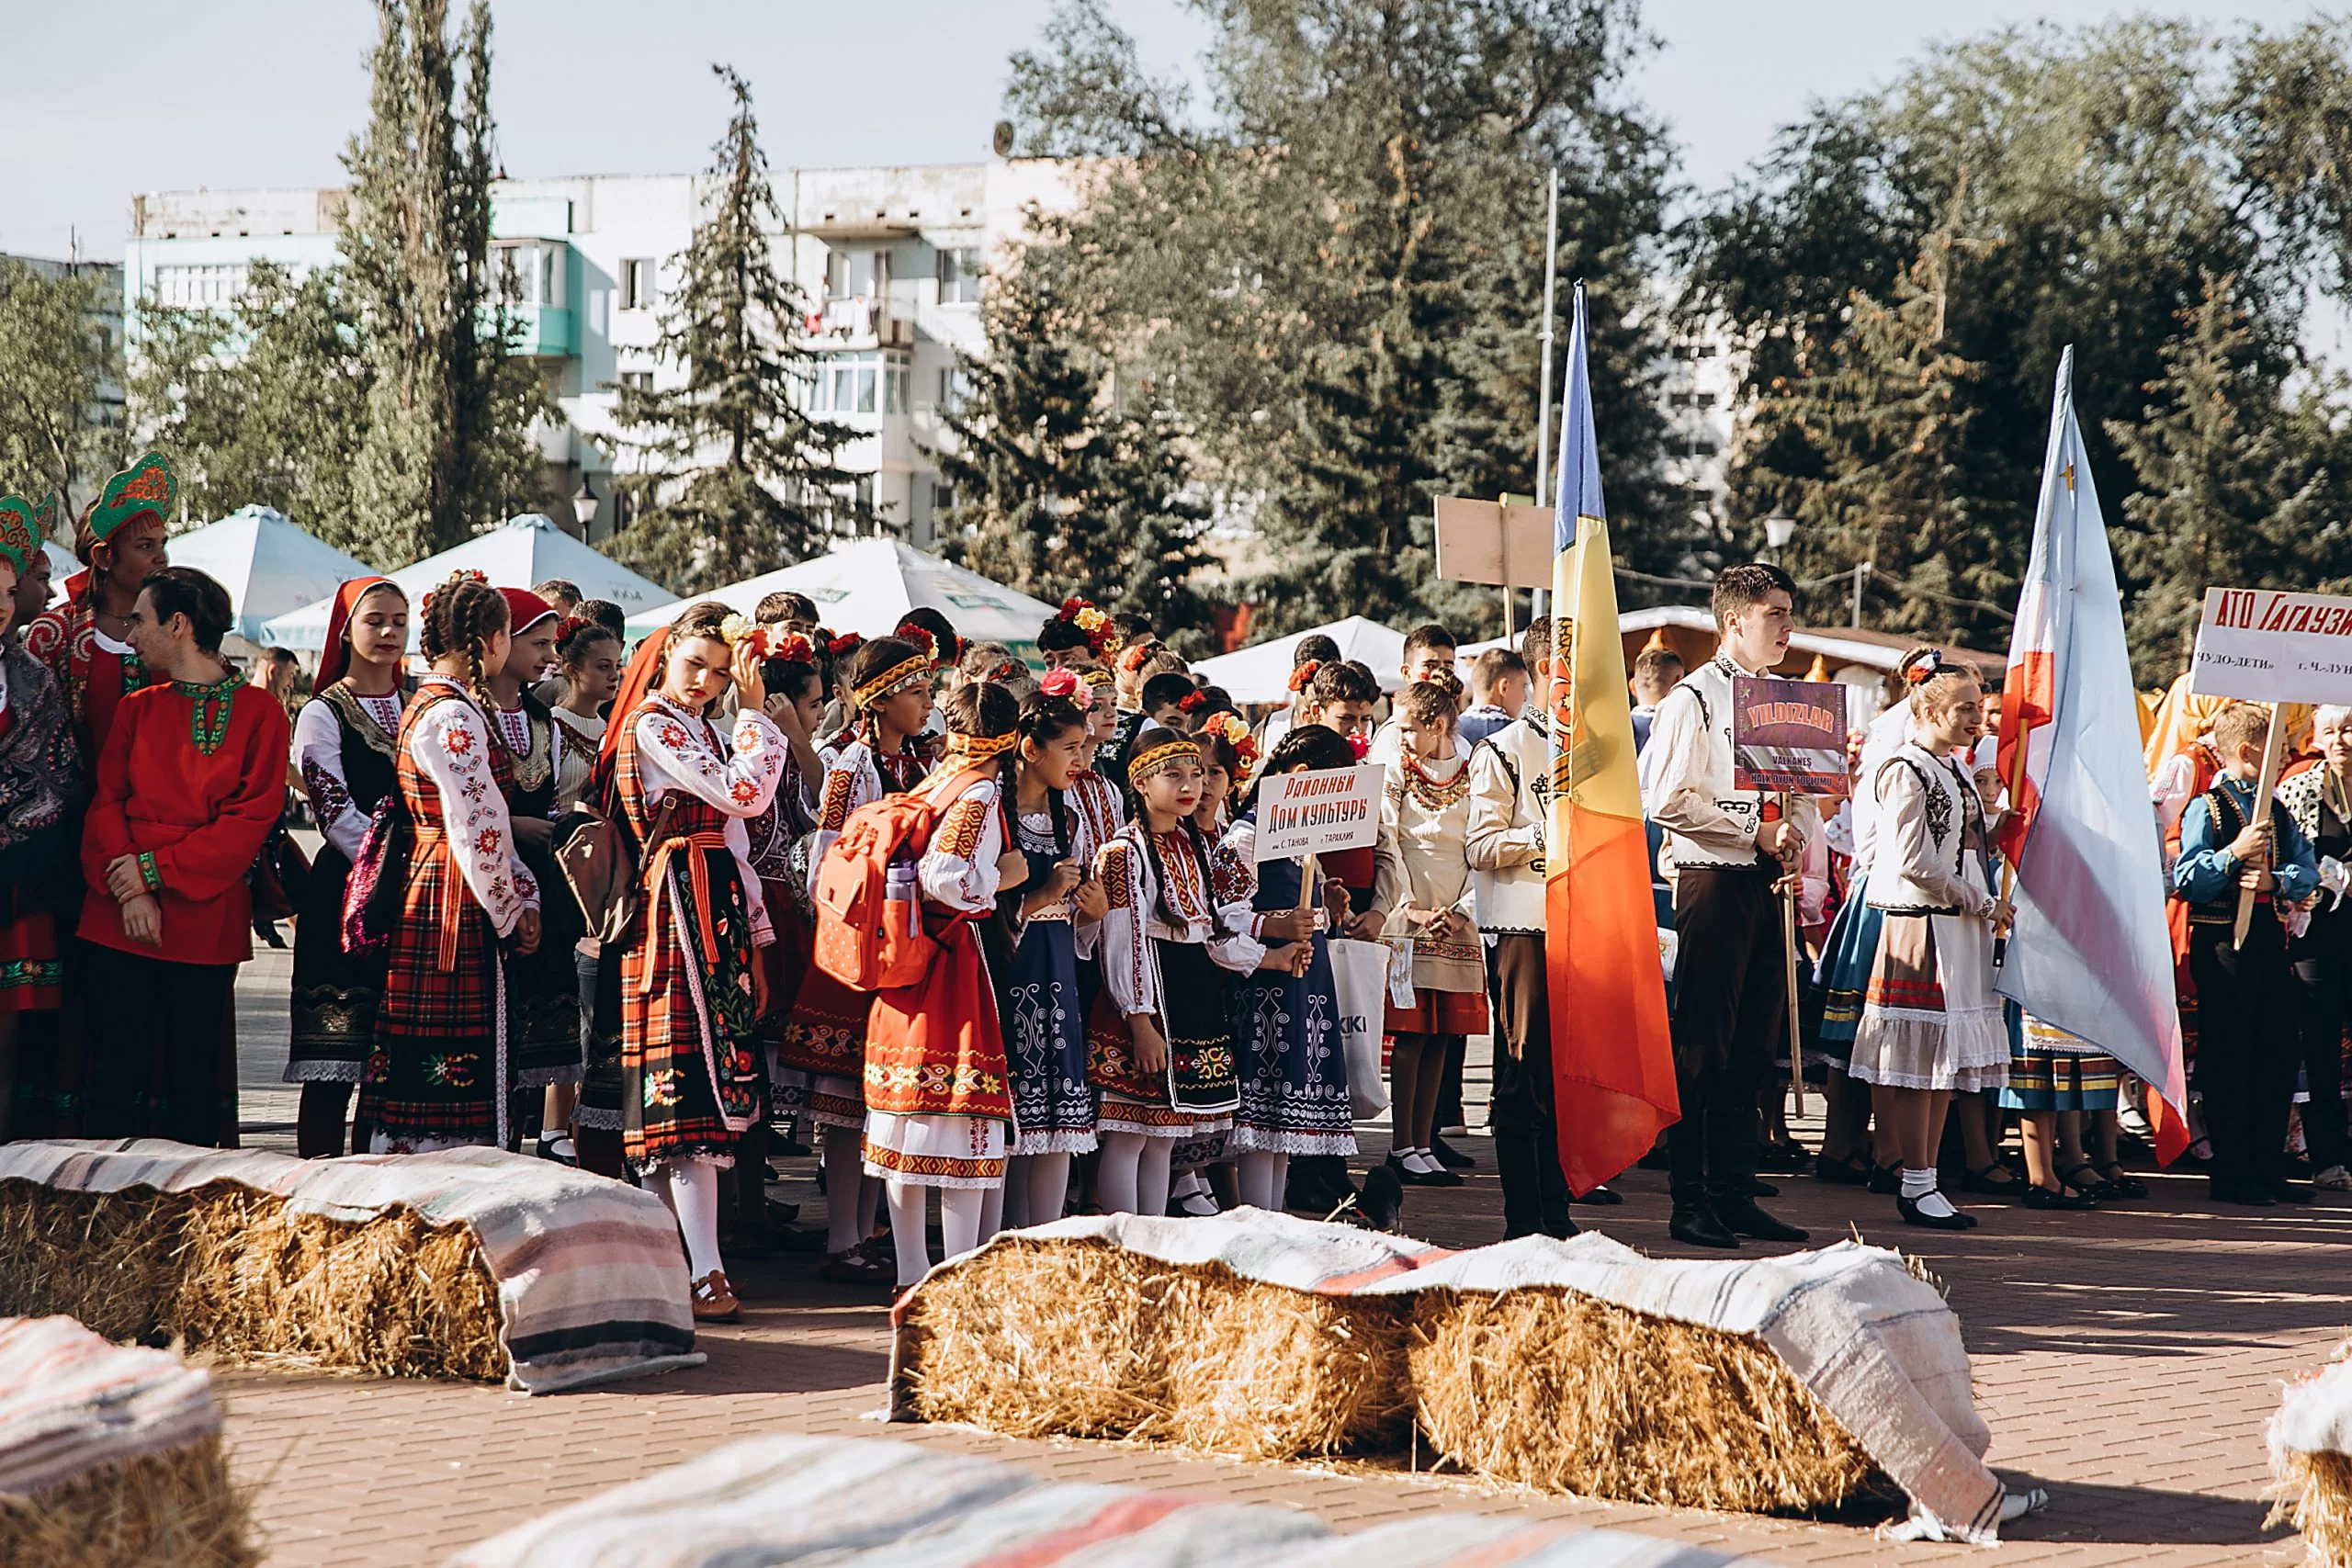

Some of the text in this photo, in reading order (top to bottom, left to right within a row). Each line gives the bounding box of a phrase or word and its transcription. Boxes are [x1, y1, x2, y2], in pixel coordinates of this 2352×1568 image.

[2215, 590, 2256, 629] АТО
[1747, 702, 1835, 734] YILDIZLAR
[1750, 773, 1771, 784] HALK
[1772, 773, 1794, 785] OYUN
[1268, 798, 1368, 834] ДОМ КУЛЬТУРЫ
[1287, 836, 1309, 849] ТАНОВА
[1324, 830, 1354, 844] ТАРАКЛИЯ
